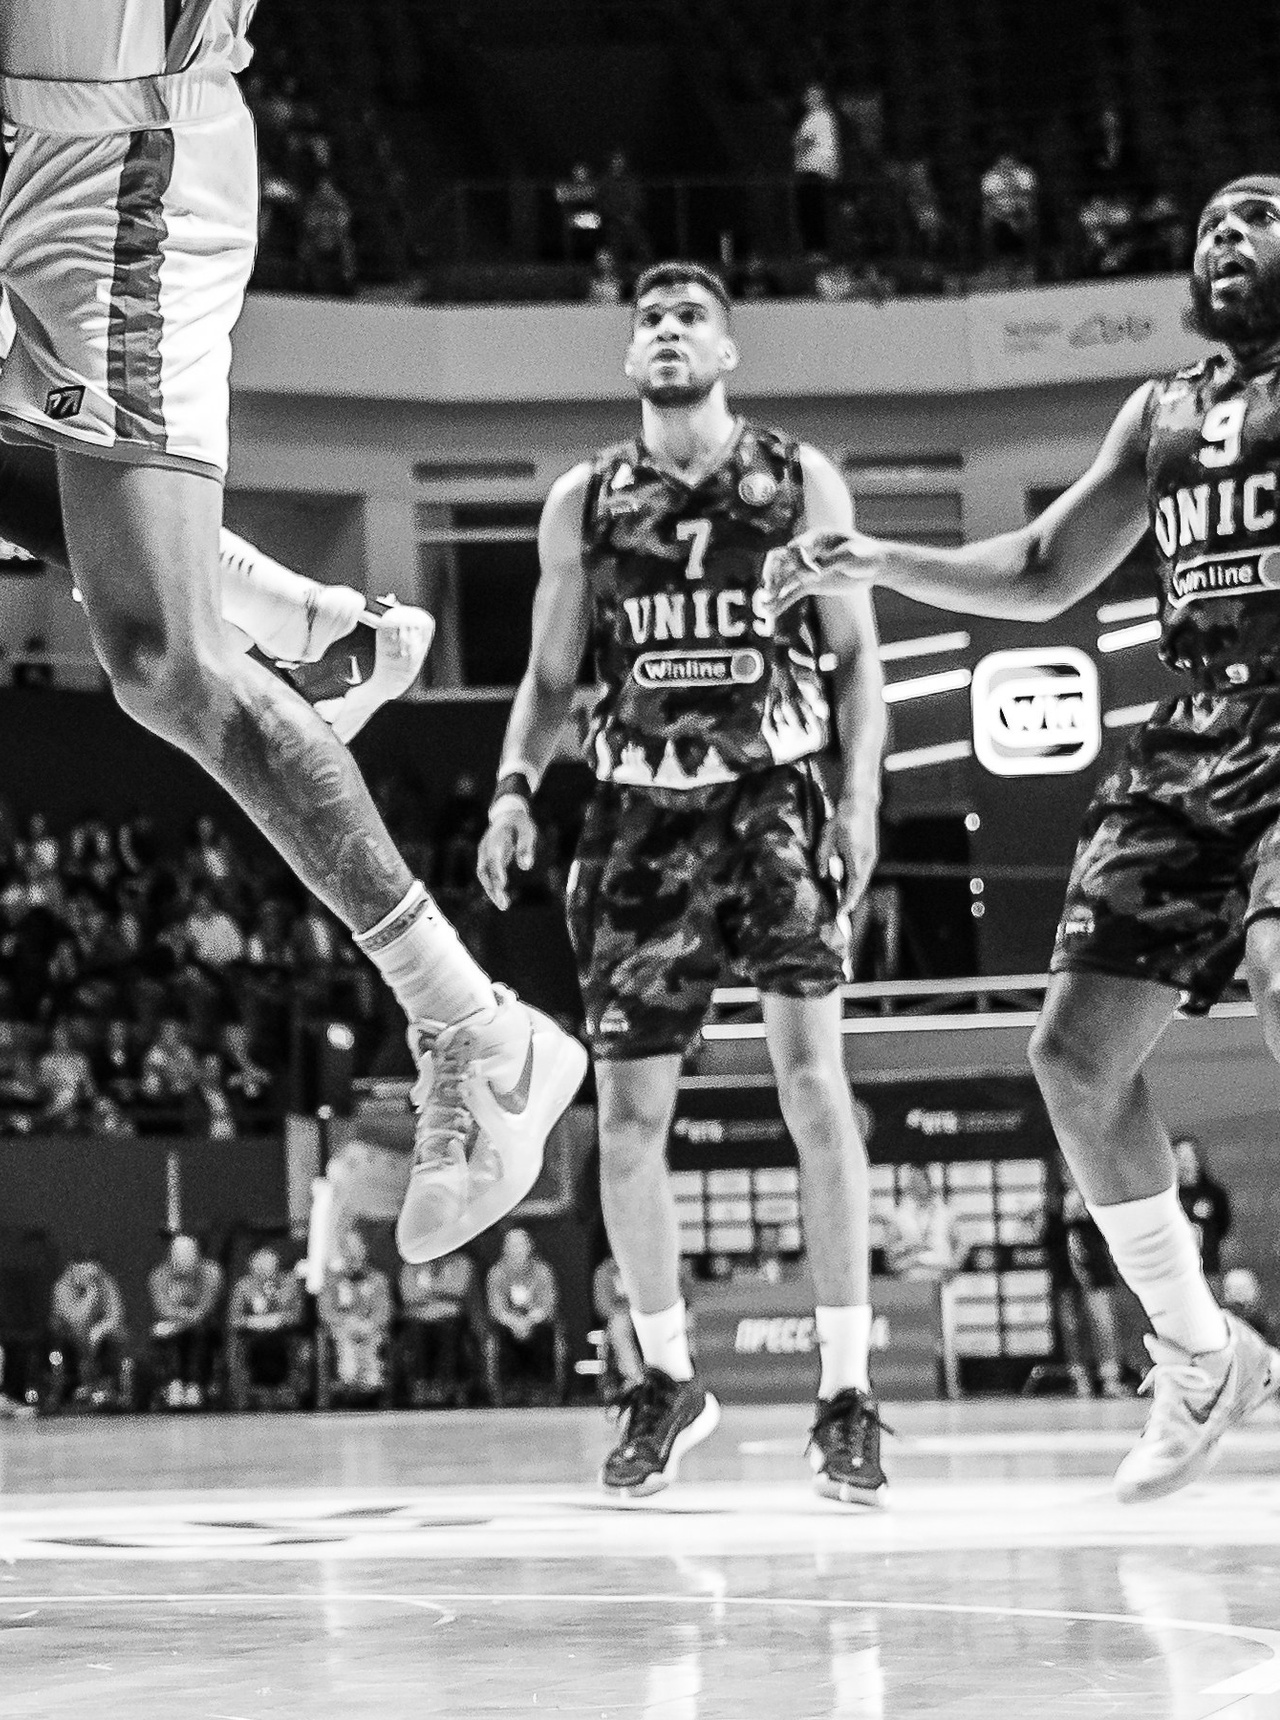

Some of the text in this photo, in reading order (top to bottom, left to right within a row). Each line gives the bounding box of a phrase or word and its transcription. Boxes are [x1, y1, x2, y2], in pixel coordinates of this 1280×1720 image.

[1198, 397, 1248, 469] 9
[676, 517, 713, 579] 7
[623, 586, 776, 644] UNICS
